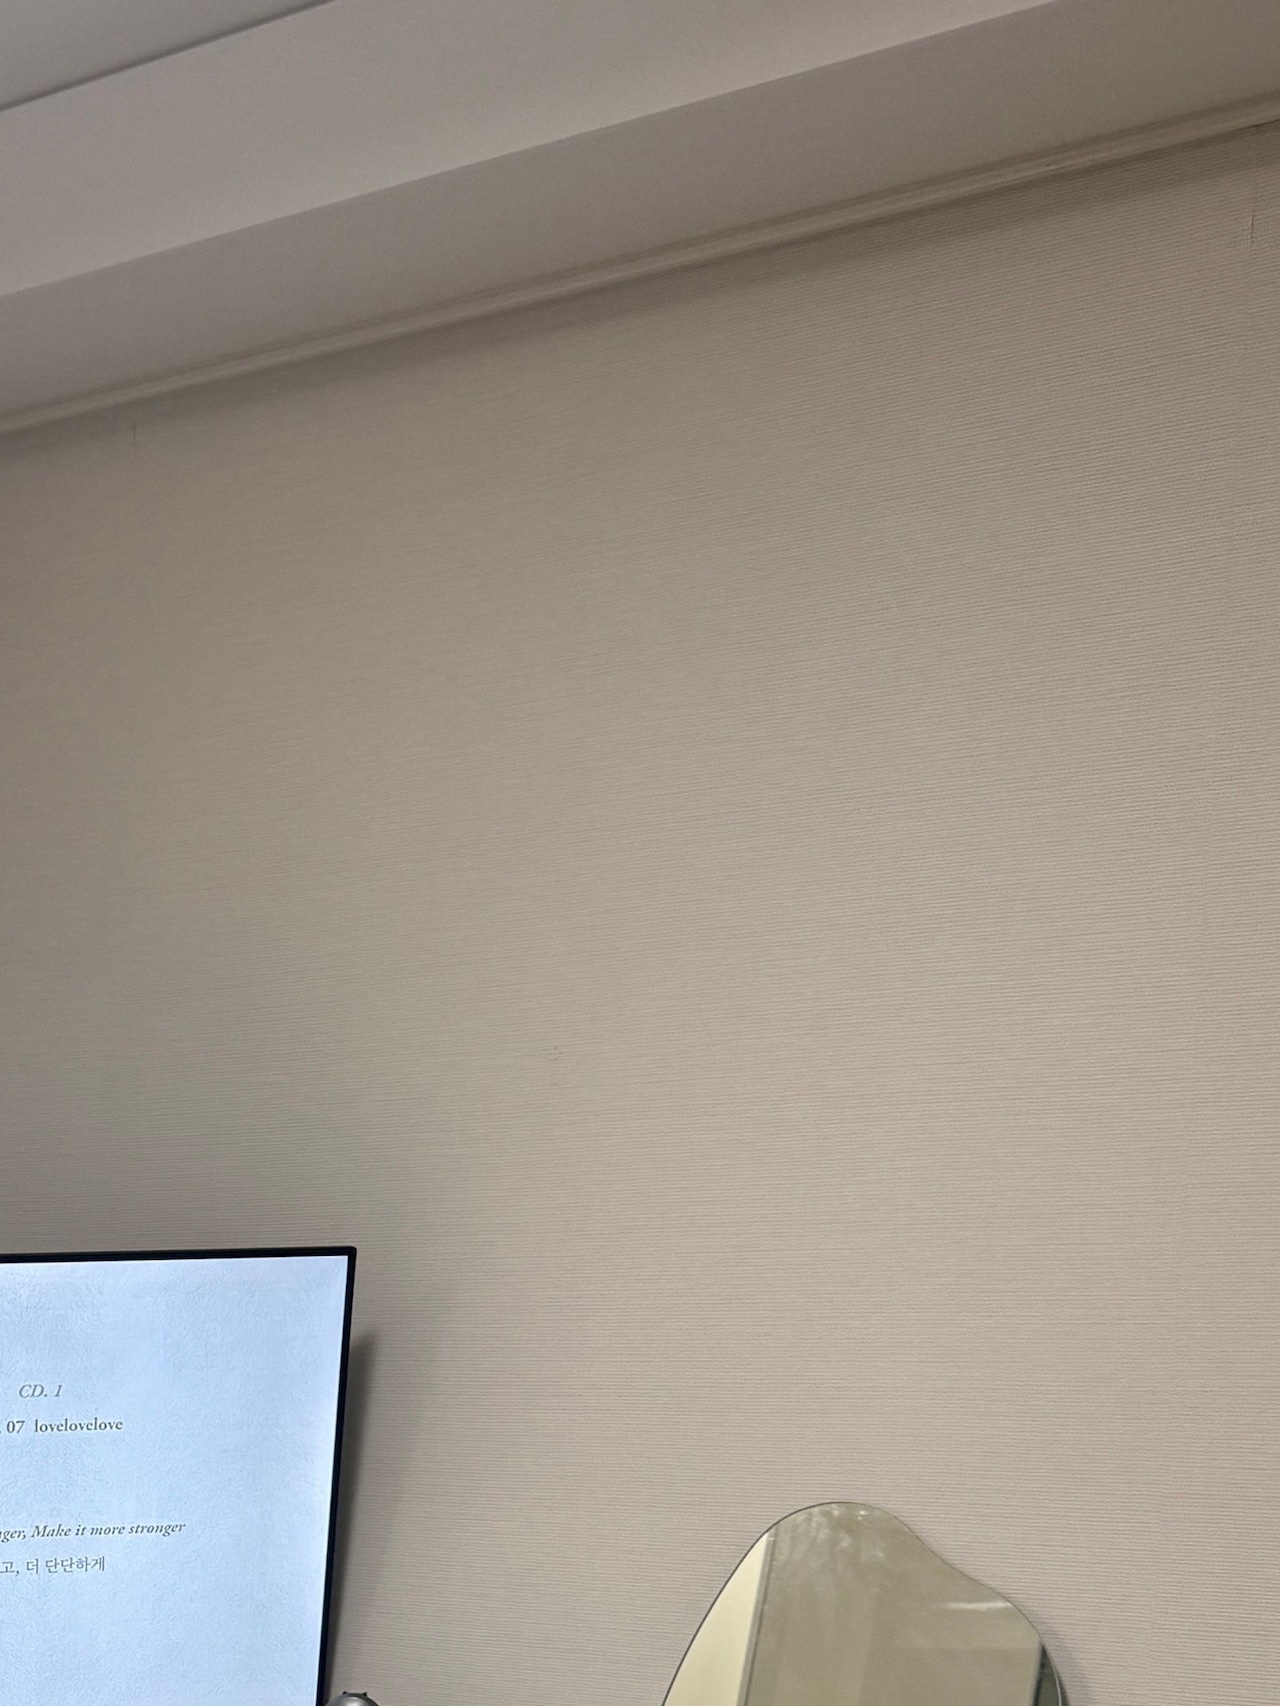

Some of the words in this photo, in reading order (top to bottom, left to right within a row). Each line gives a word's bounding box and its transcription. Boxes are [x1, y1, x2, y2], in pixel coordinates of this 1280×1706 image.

[19, 1384, 48, 1399] CD.
[54, 1384, 63, 1397] 1
[6, 1420, 25, 1434] 07
[34, 1418, 124, 1433] lovelovelove
[30, 1524, 71, 1539] Make
[75, 1524, 87, 1537] it
[90, 1525, 125, 1536] more
[128, 1522, 186, 1536] stronger
[26, 1558, 40, 1575] 더
[45, 1556, 106, 1574] 단단하게
